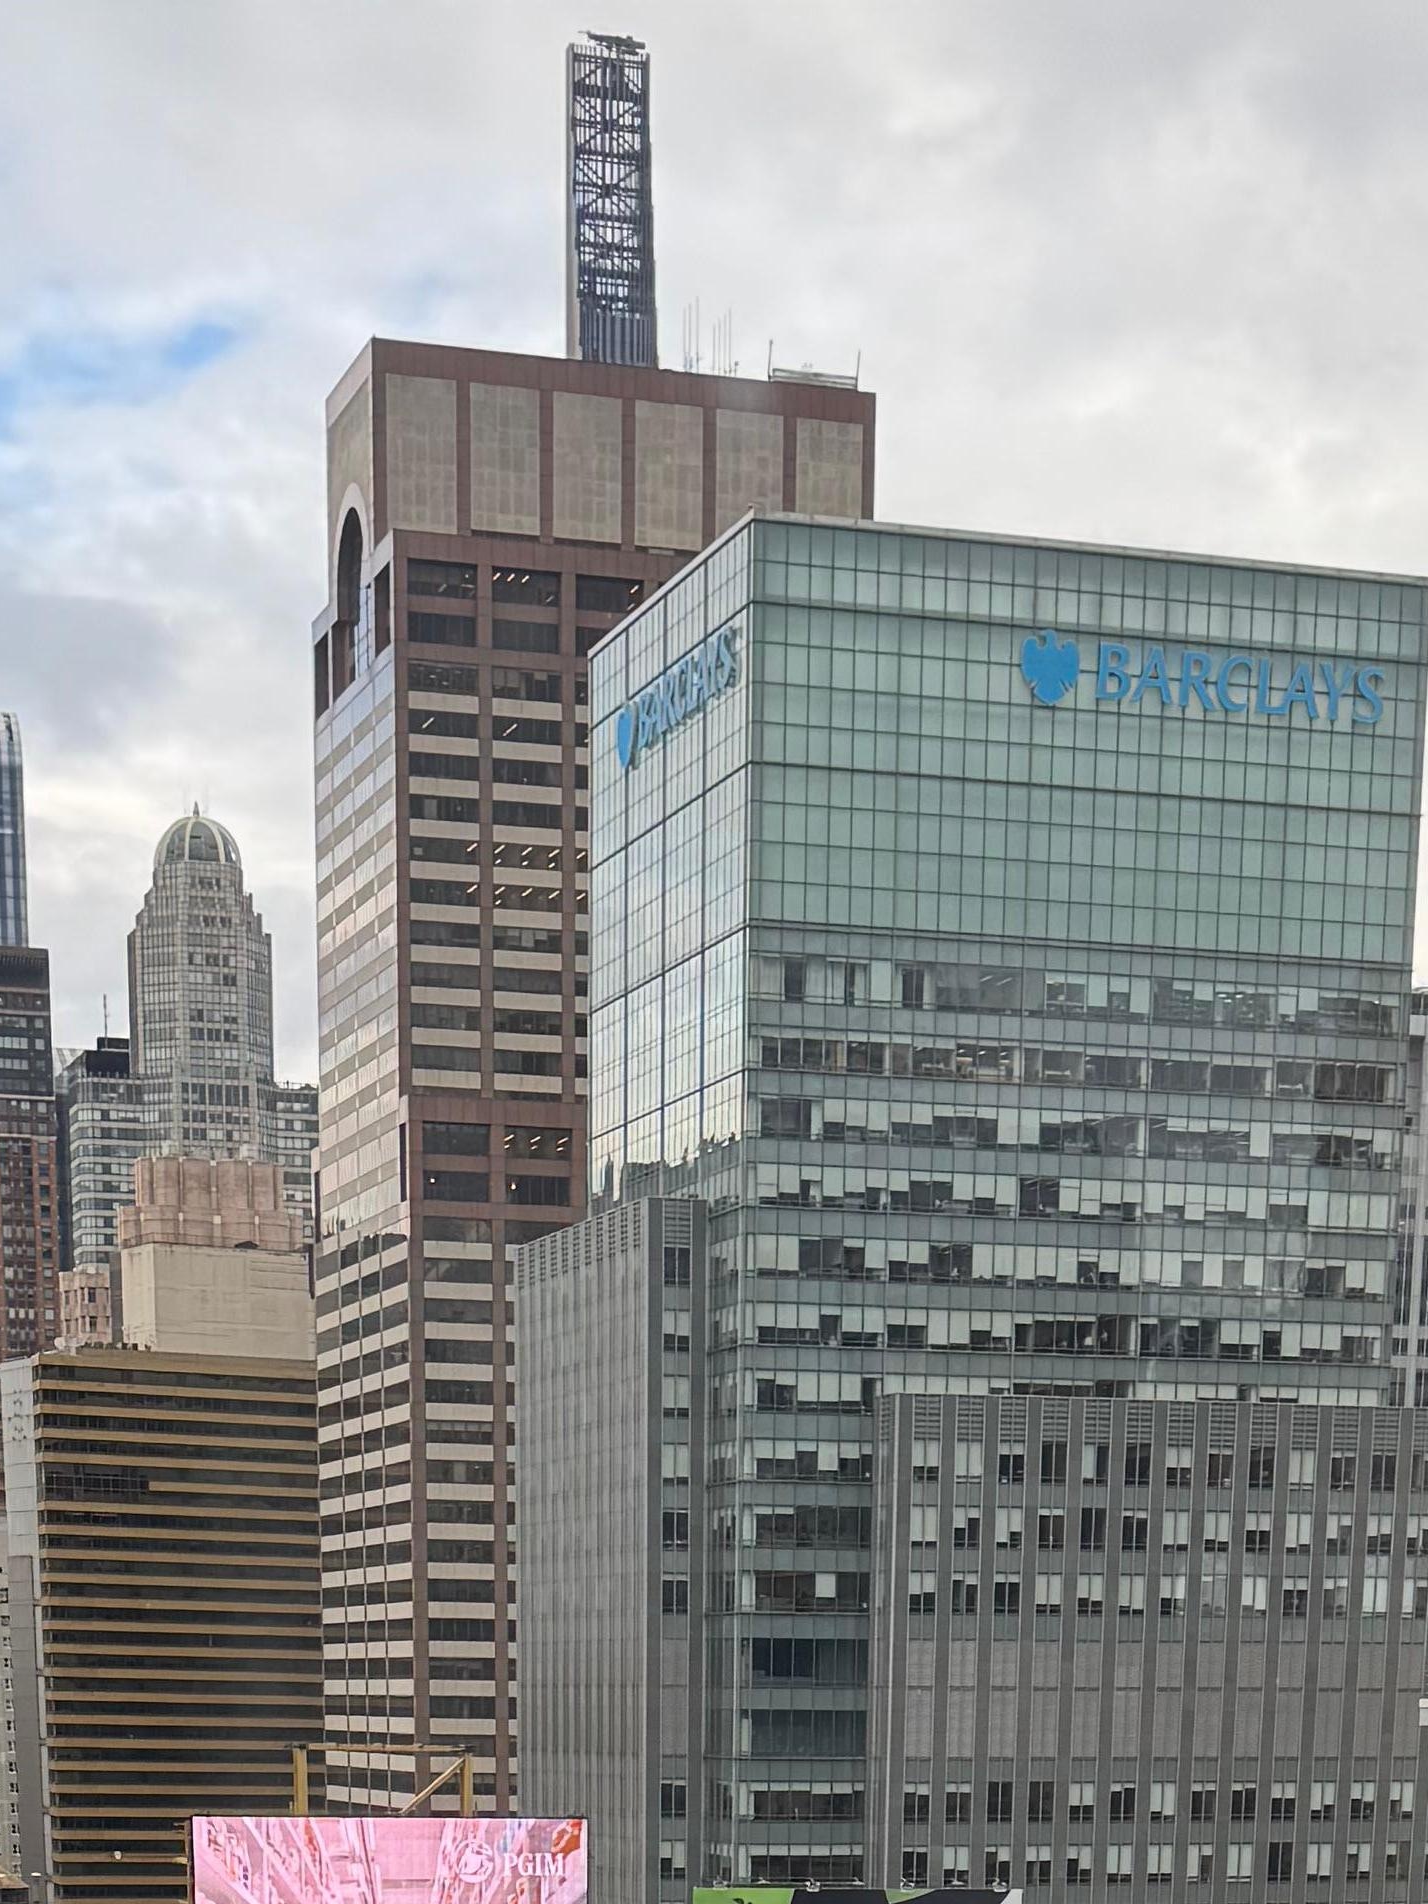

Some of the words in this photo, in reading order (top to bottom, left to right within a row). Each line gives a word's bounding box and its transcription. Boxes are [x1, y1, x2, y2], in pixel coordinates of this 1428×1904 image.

[635, 625, 739, 742] BARCLAYS
[1093, 642, 1386, 727] BARCLAYS
[503, 1852, 564, 1877] PGIM
